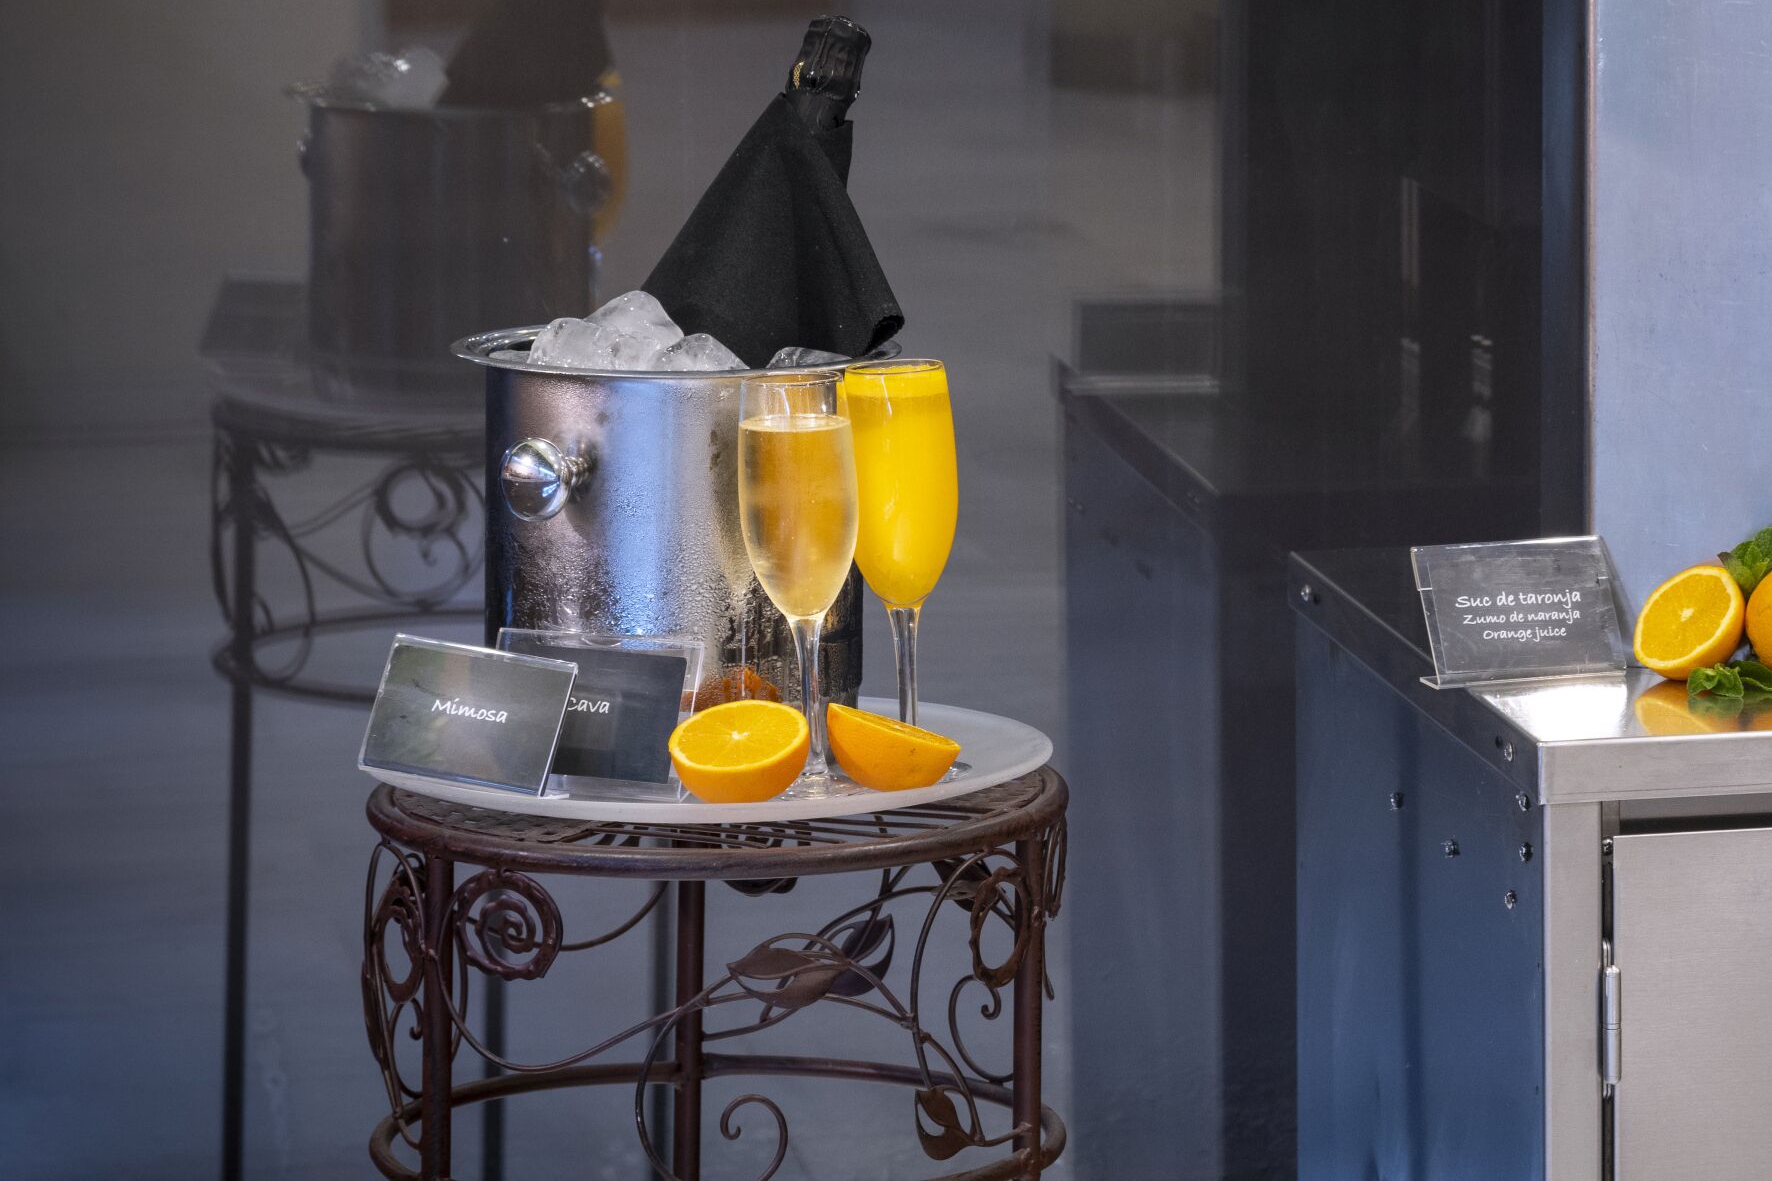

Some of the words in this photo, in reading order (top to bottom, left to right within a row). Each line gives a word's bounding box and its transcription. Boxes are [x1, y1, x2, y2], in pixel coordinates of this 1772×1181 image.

[1455, 595, 1492, 608] Suc
[1496, 592, 1516, 606] de
[1519, 589, 1581, 608] taronja
[1463, 614, 1506, 625] Zumo
[1509, 611, 1525, 623] de
[1527, 609, 1581, 624] naranja
[1483, 628, 1533, 641] Orange
[1532, 626, 1567, 642] juice
[431, 698, 508, 724] Mimosa
